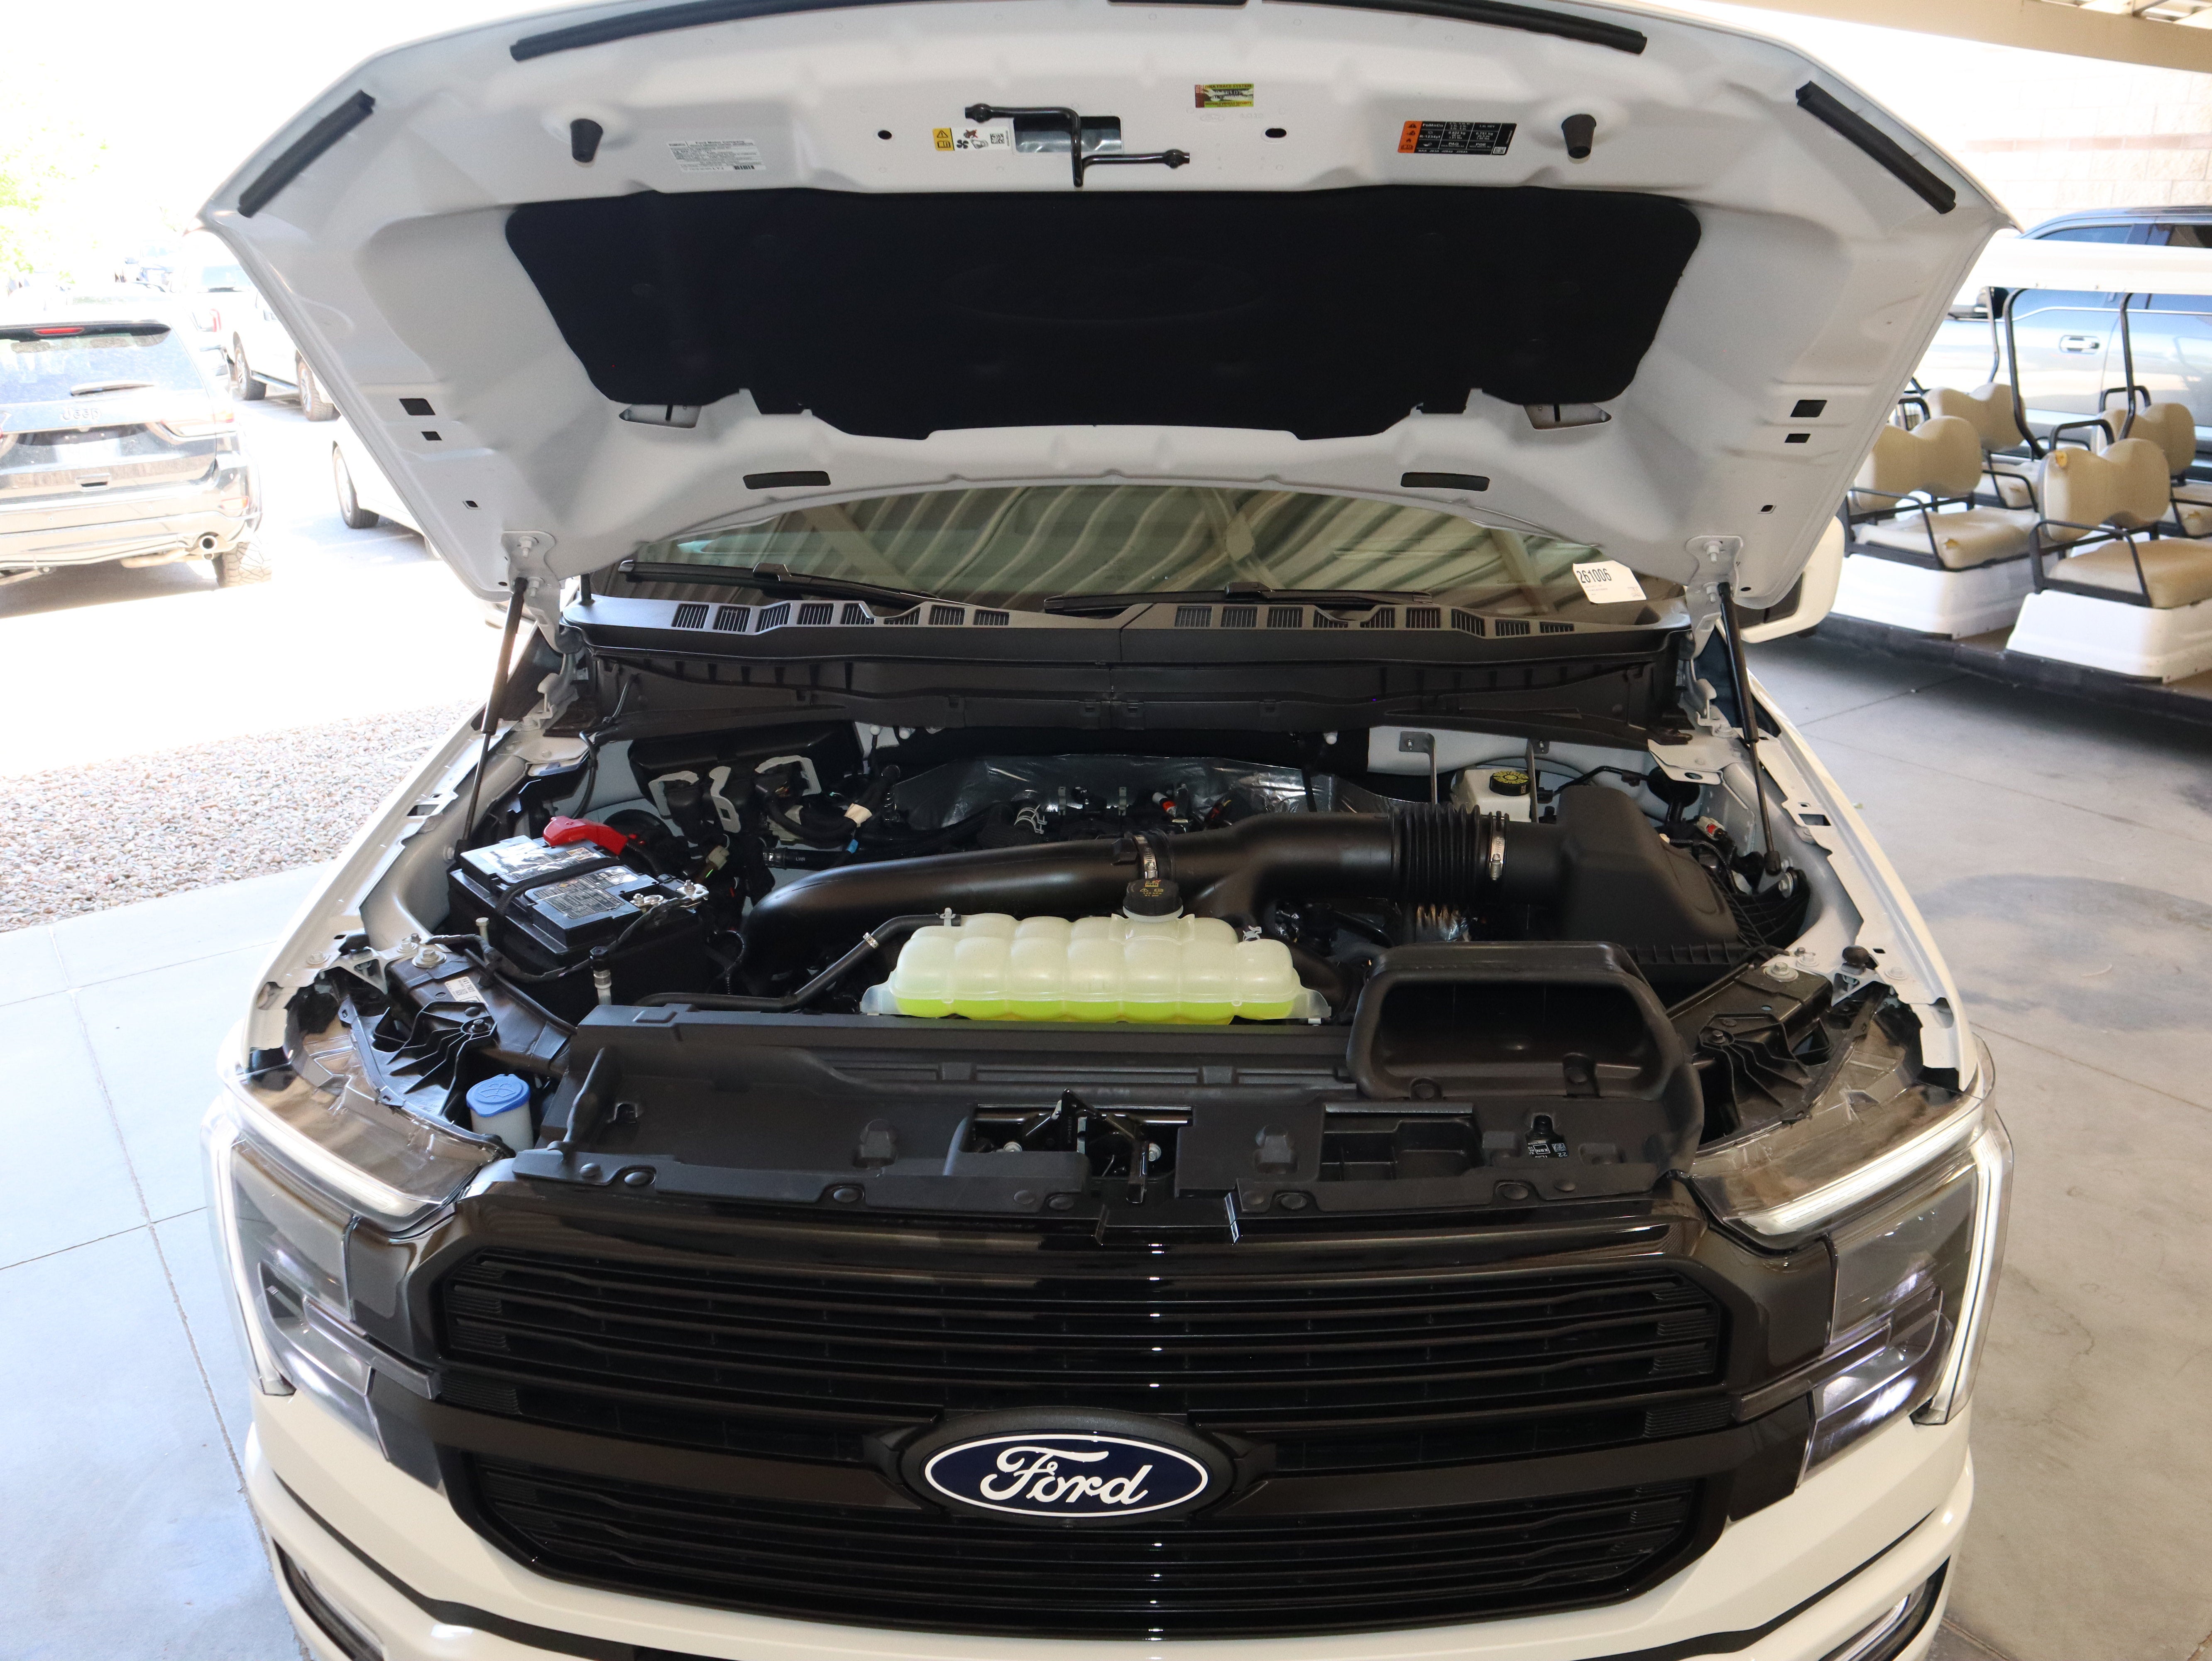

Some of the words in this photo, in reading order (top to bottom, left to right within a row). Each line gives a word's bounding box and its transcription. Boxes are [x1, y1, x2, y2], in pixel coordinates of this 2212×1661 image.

[60, 407, 102, 421] Jeep
[1576, 568, 1612, 583] 261006
[980, 1446, 1153, 1505] Ford
